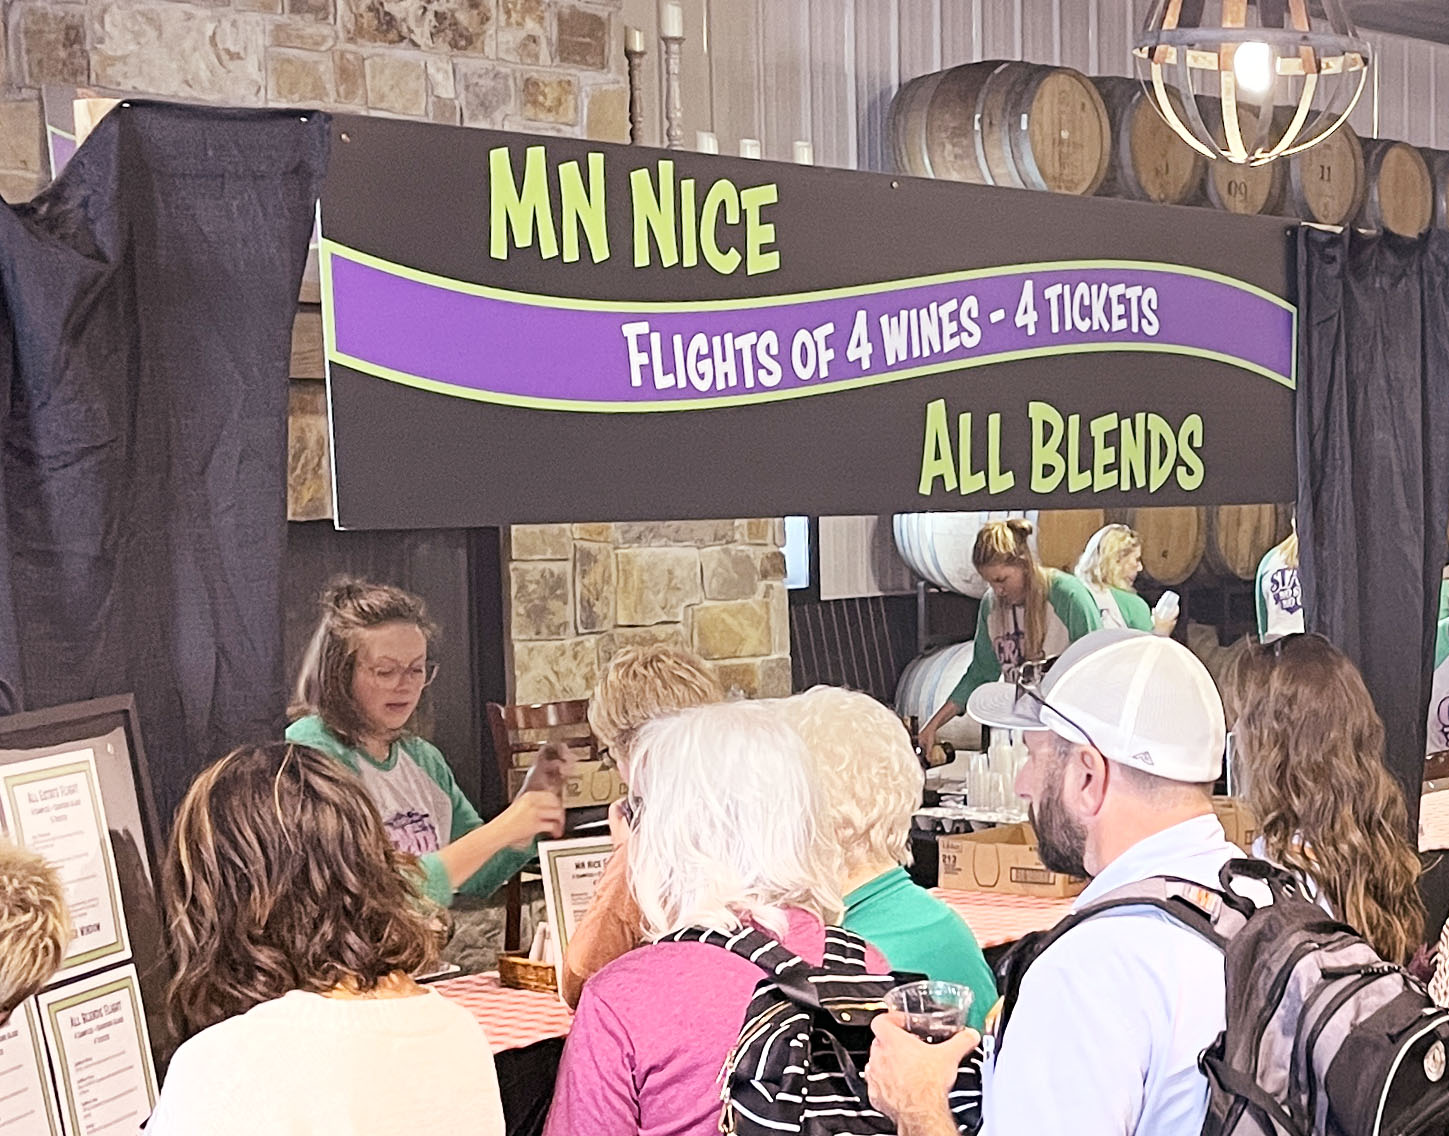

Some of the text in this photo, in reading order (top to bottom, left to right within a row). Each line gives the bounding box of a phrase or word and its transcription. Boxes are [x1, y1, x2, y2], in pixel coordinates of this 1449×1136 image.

[488, 145, 781, 276] MN NICE
[620, 320, 783, 392] FLIGHTS
[790, 321, 836, 382] OF
[845, 308, 874, 372] 4
[879, 295, 982, 367] WINES
[1013, 278, 1038, 337] 4
[1044, 281, 1161, 337] TICKETS
[919, 398, 1204, 495] ALL BLENDS
